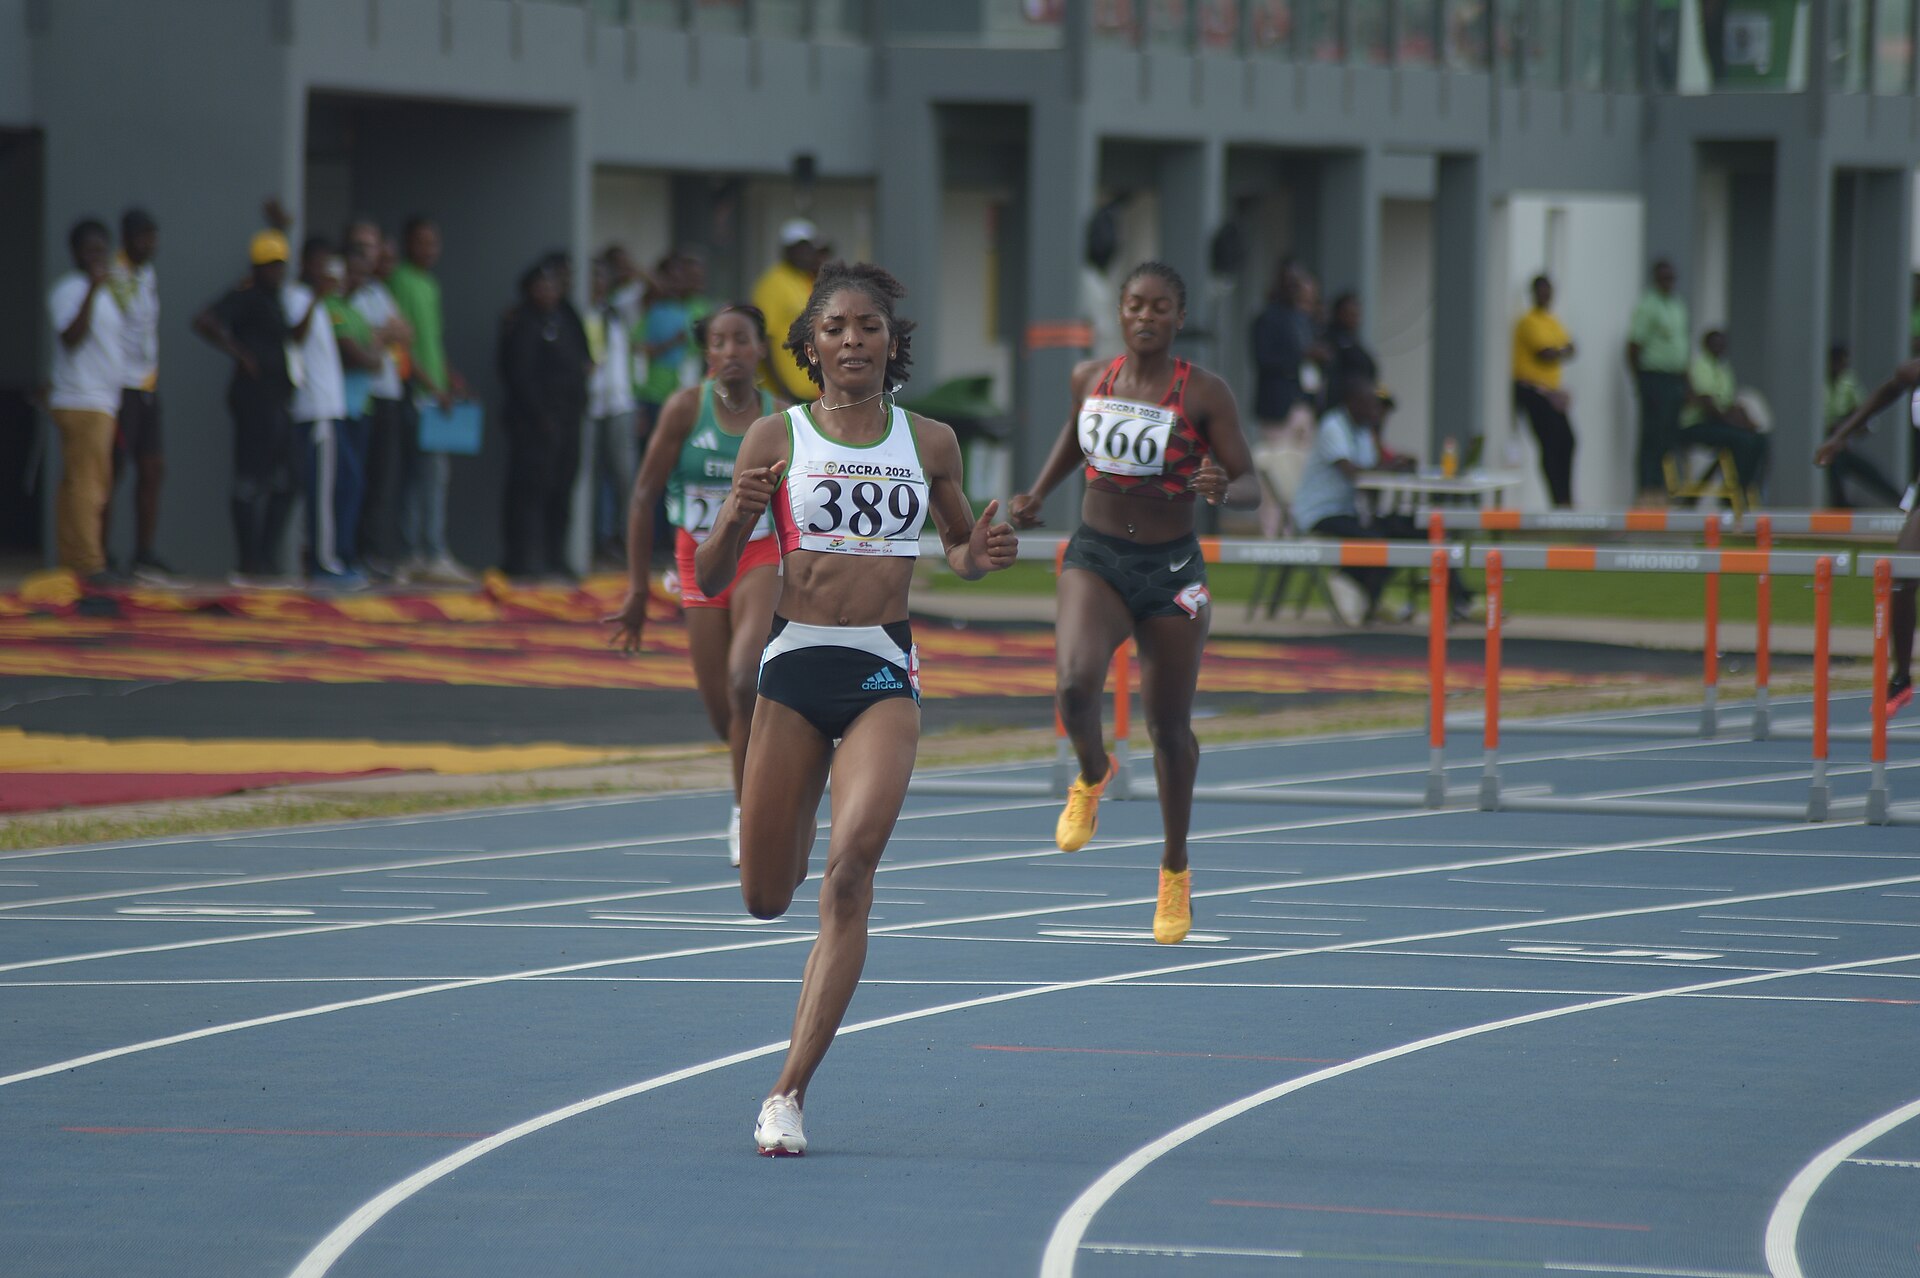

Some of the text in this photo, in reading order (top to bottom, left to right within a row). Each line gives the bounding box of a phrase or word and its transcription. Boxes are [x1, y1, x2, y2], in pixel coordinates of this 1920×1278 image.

[1104, 403, 1161, 419] ACCRA 2023
[1083, 413, 1163, 465] 366
[837, 464, 911, 478] ACCRA 2023
[808, 479, 919, 538] 389
[1628, 554, 1698, 570] MONDO
[861, 681, 903, 690] adidas
